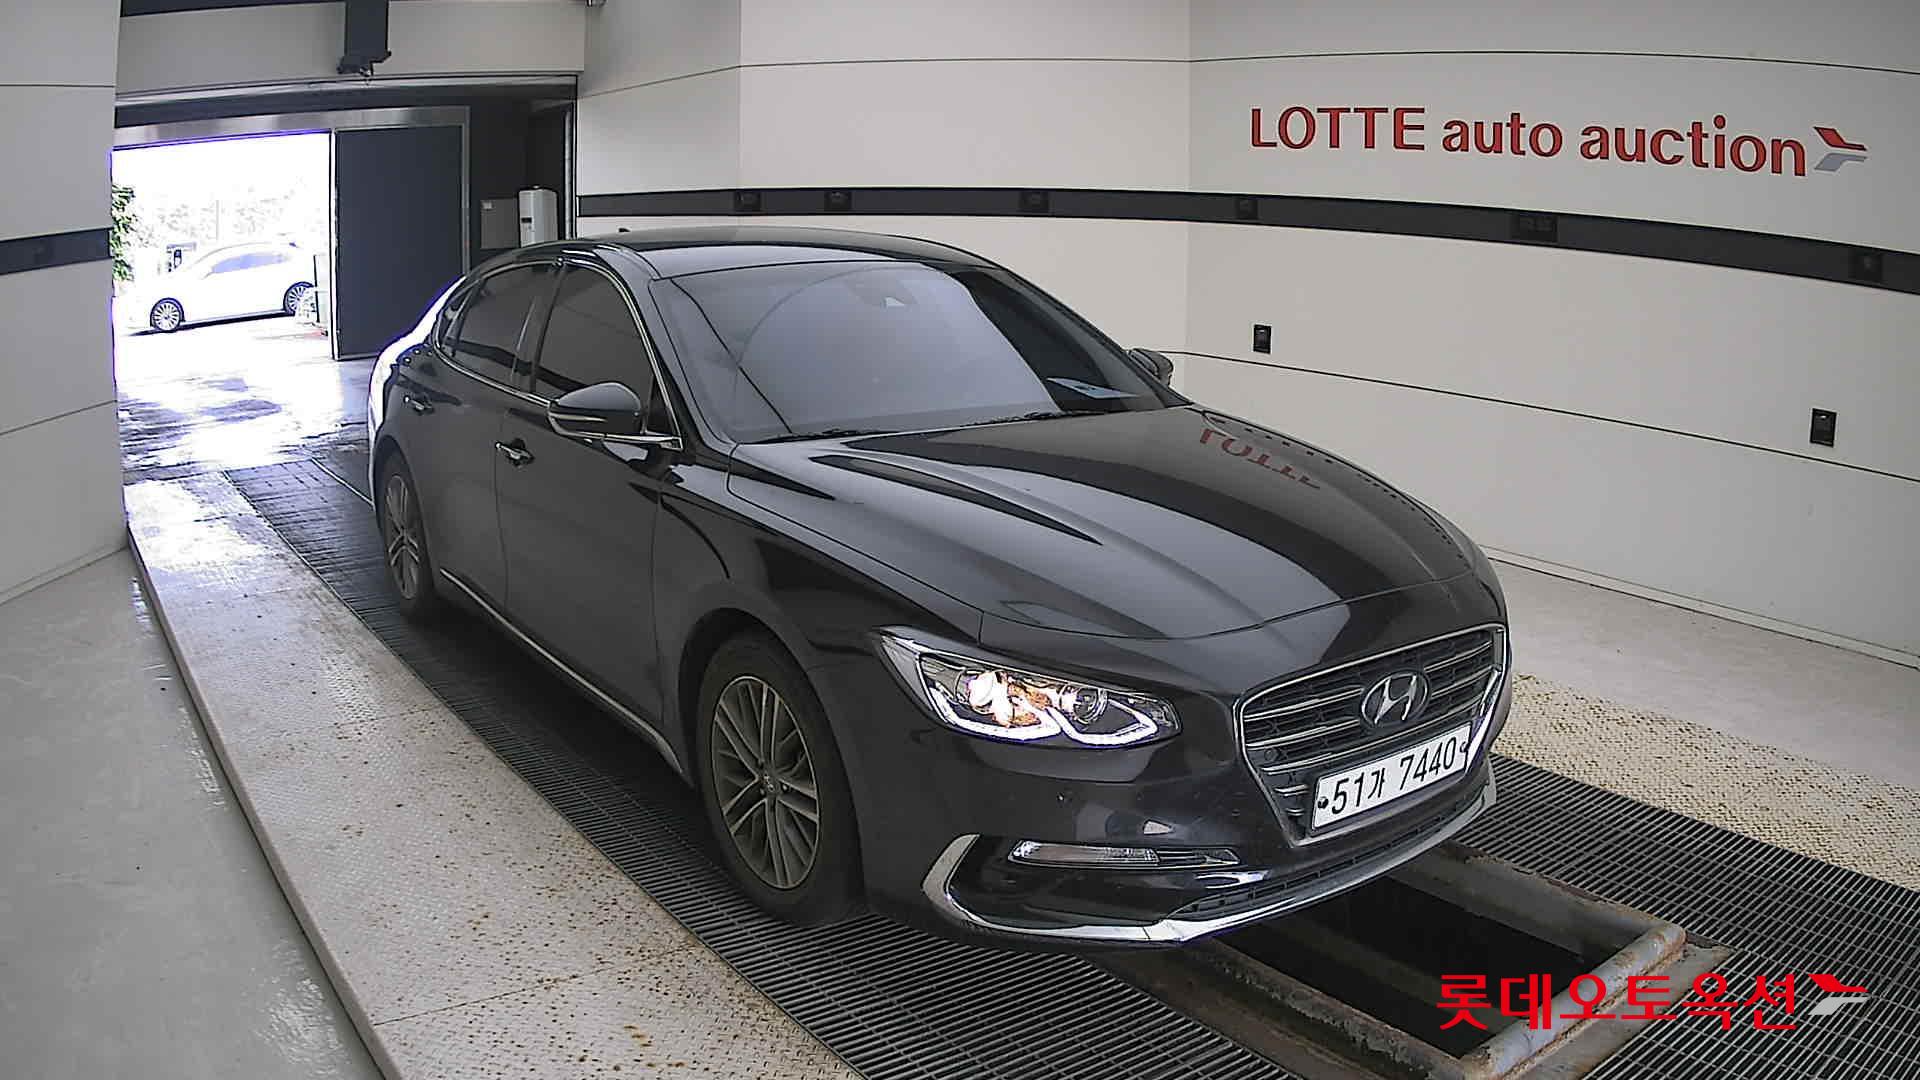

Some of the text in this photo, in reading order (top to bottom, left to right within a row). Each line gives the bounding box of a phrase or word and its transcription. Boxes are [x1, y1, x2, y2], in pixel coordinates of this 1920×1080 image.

[1251, 106, 1807, 177] LOTTE auto auction
[1330, 736, 1457, 815] 51가 7440
